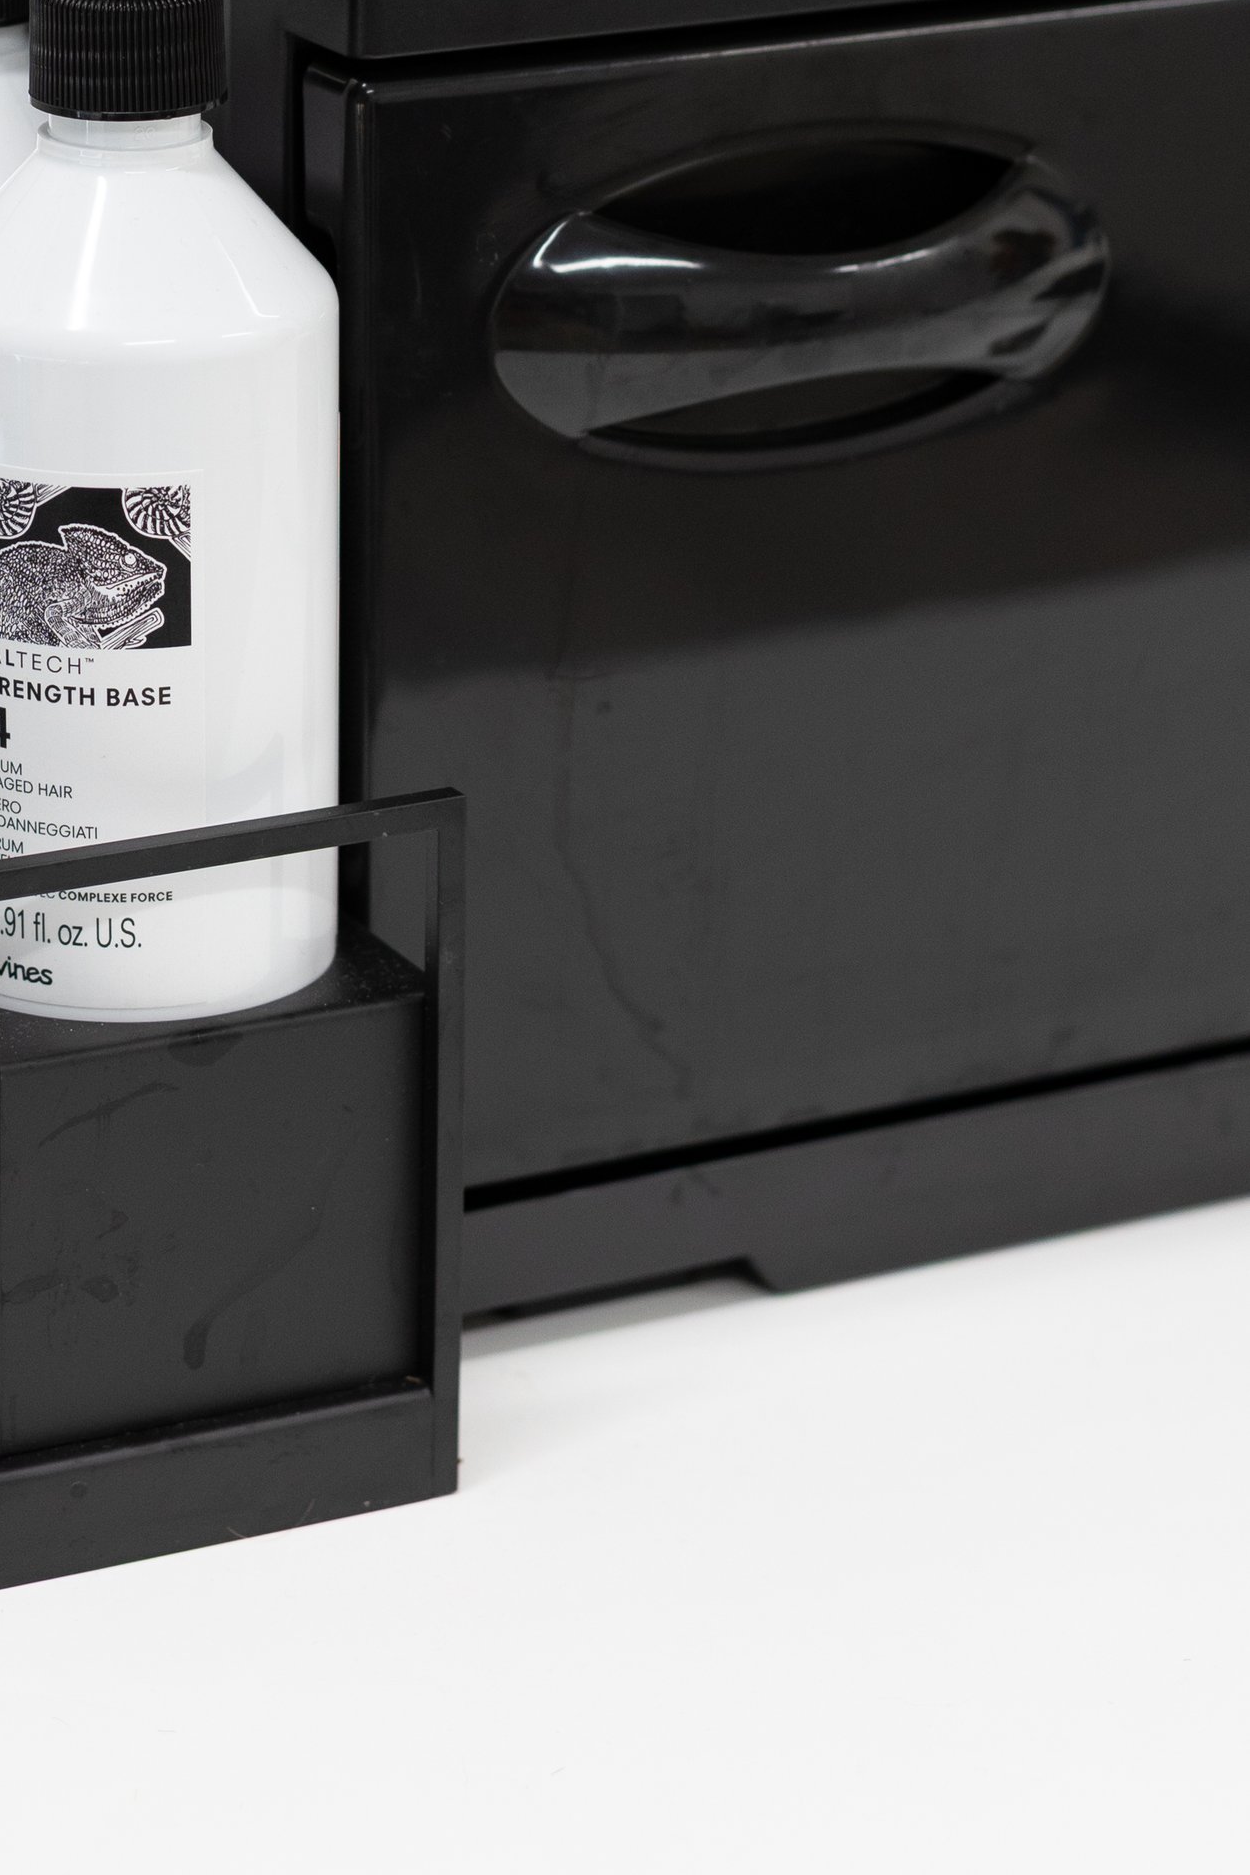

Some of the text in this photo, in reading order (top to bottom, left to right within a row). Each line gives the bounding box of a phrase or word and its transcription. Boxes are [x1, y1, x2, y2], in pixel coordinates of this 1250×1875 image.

[106, 686, 172, 707] BASE
[38, 782, 73, 799] HAIR
[58, 890, 127, 903] COMPLEXE
[130, 891, 173, 903] FORCE
[33, 911, 52, 944] fl.
[57, 923, 88, 947] oz.
[96, 917, 142, 948] U.S.
